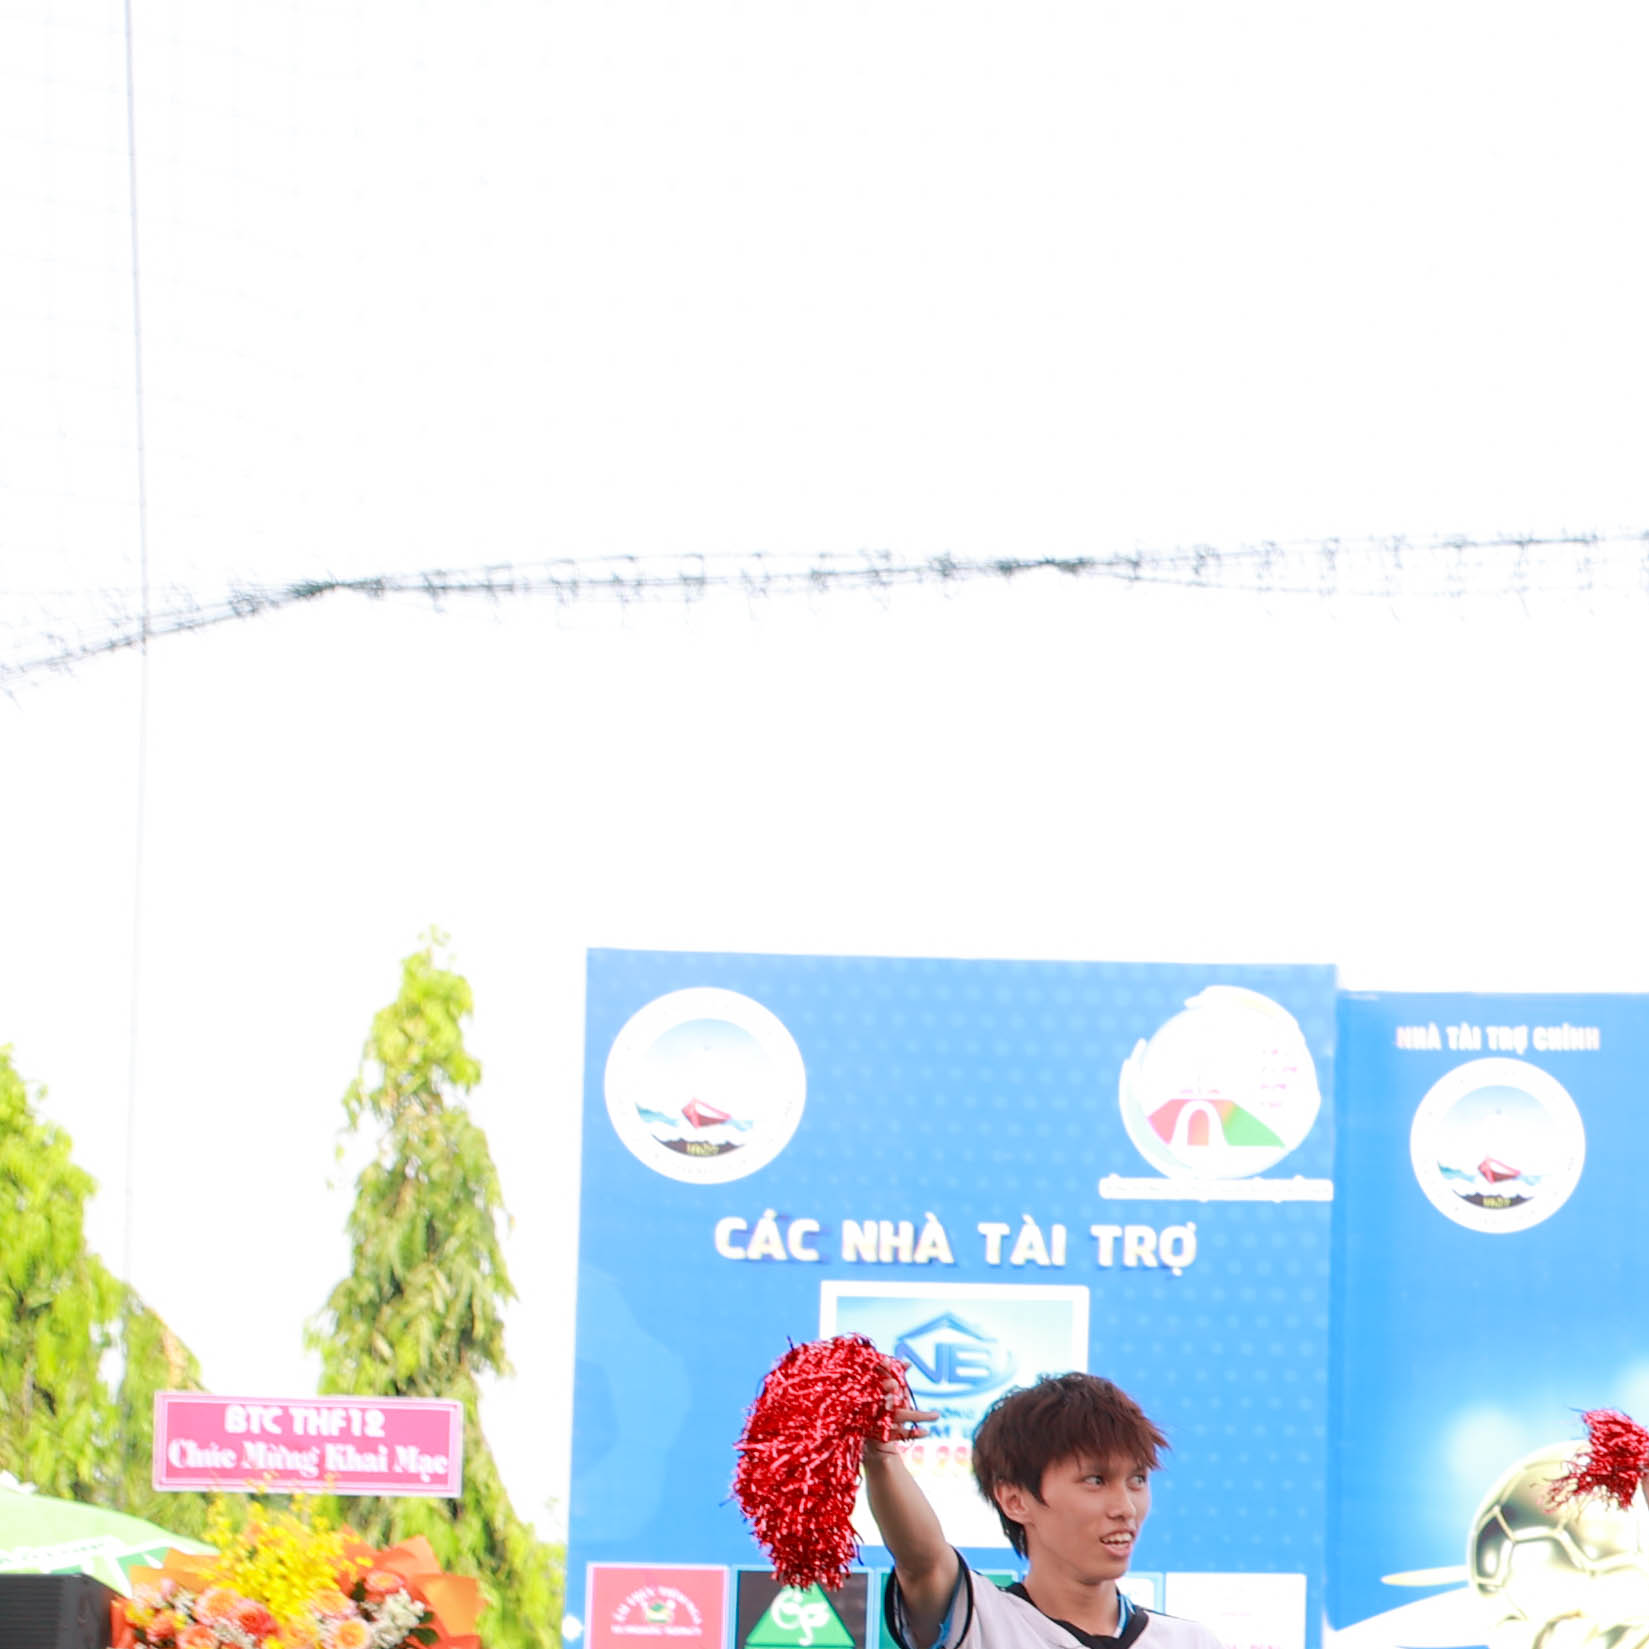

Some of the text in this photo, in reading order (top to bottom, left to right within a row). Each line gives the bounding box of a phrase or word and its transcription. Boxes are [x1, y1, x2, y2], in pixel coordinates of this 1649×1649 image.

[715, 1209, 1197, 1277] CÁC NHÀ TÀI TRỢ
[224, 1404, 283, 1434] BTC
[324, 1443, 388, 1473] Khai
